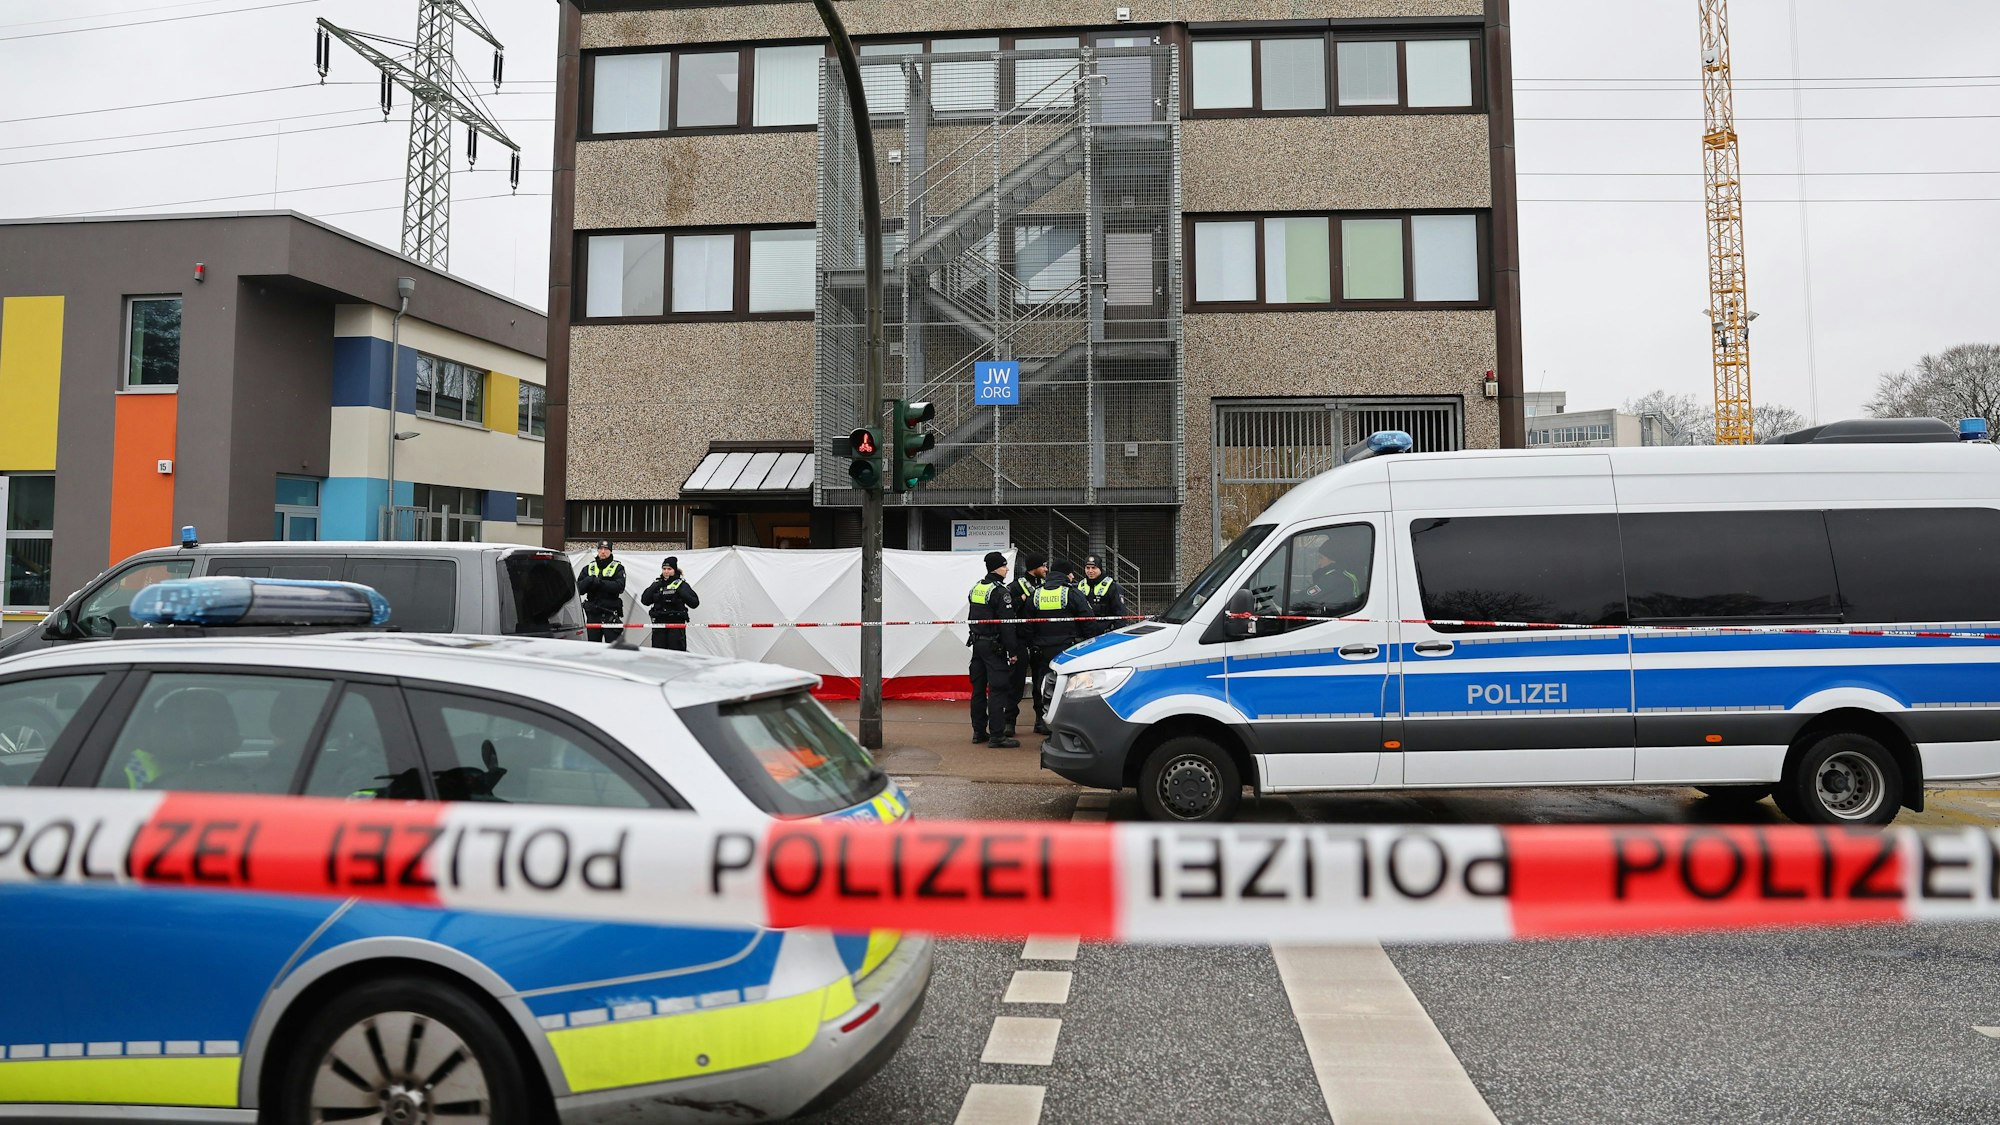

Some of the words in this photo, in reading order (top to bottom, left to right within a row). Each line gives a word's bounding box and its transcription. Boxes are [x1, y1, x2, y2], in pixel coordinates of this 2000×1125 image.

[980, 386, 1011, 399] .ORG
[983, 368, 1011, 385] JW
[159, 462, 167, 472] 15
[1467, 683, 1568, 704] POLIZEI
[326, 824, 628, 891] POLIZEI
[710, 831, 1054, 900] POLIZEI
[1150, 830, 1512, 900] POLIZEI
[1612, 828, 2000, 900] POLIZEI
